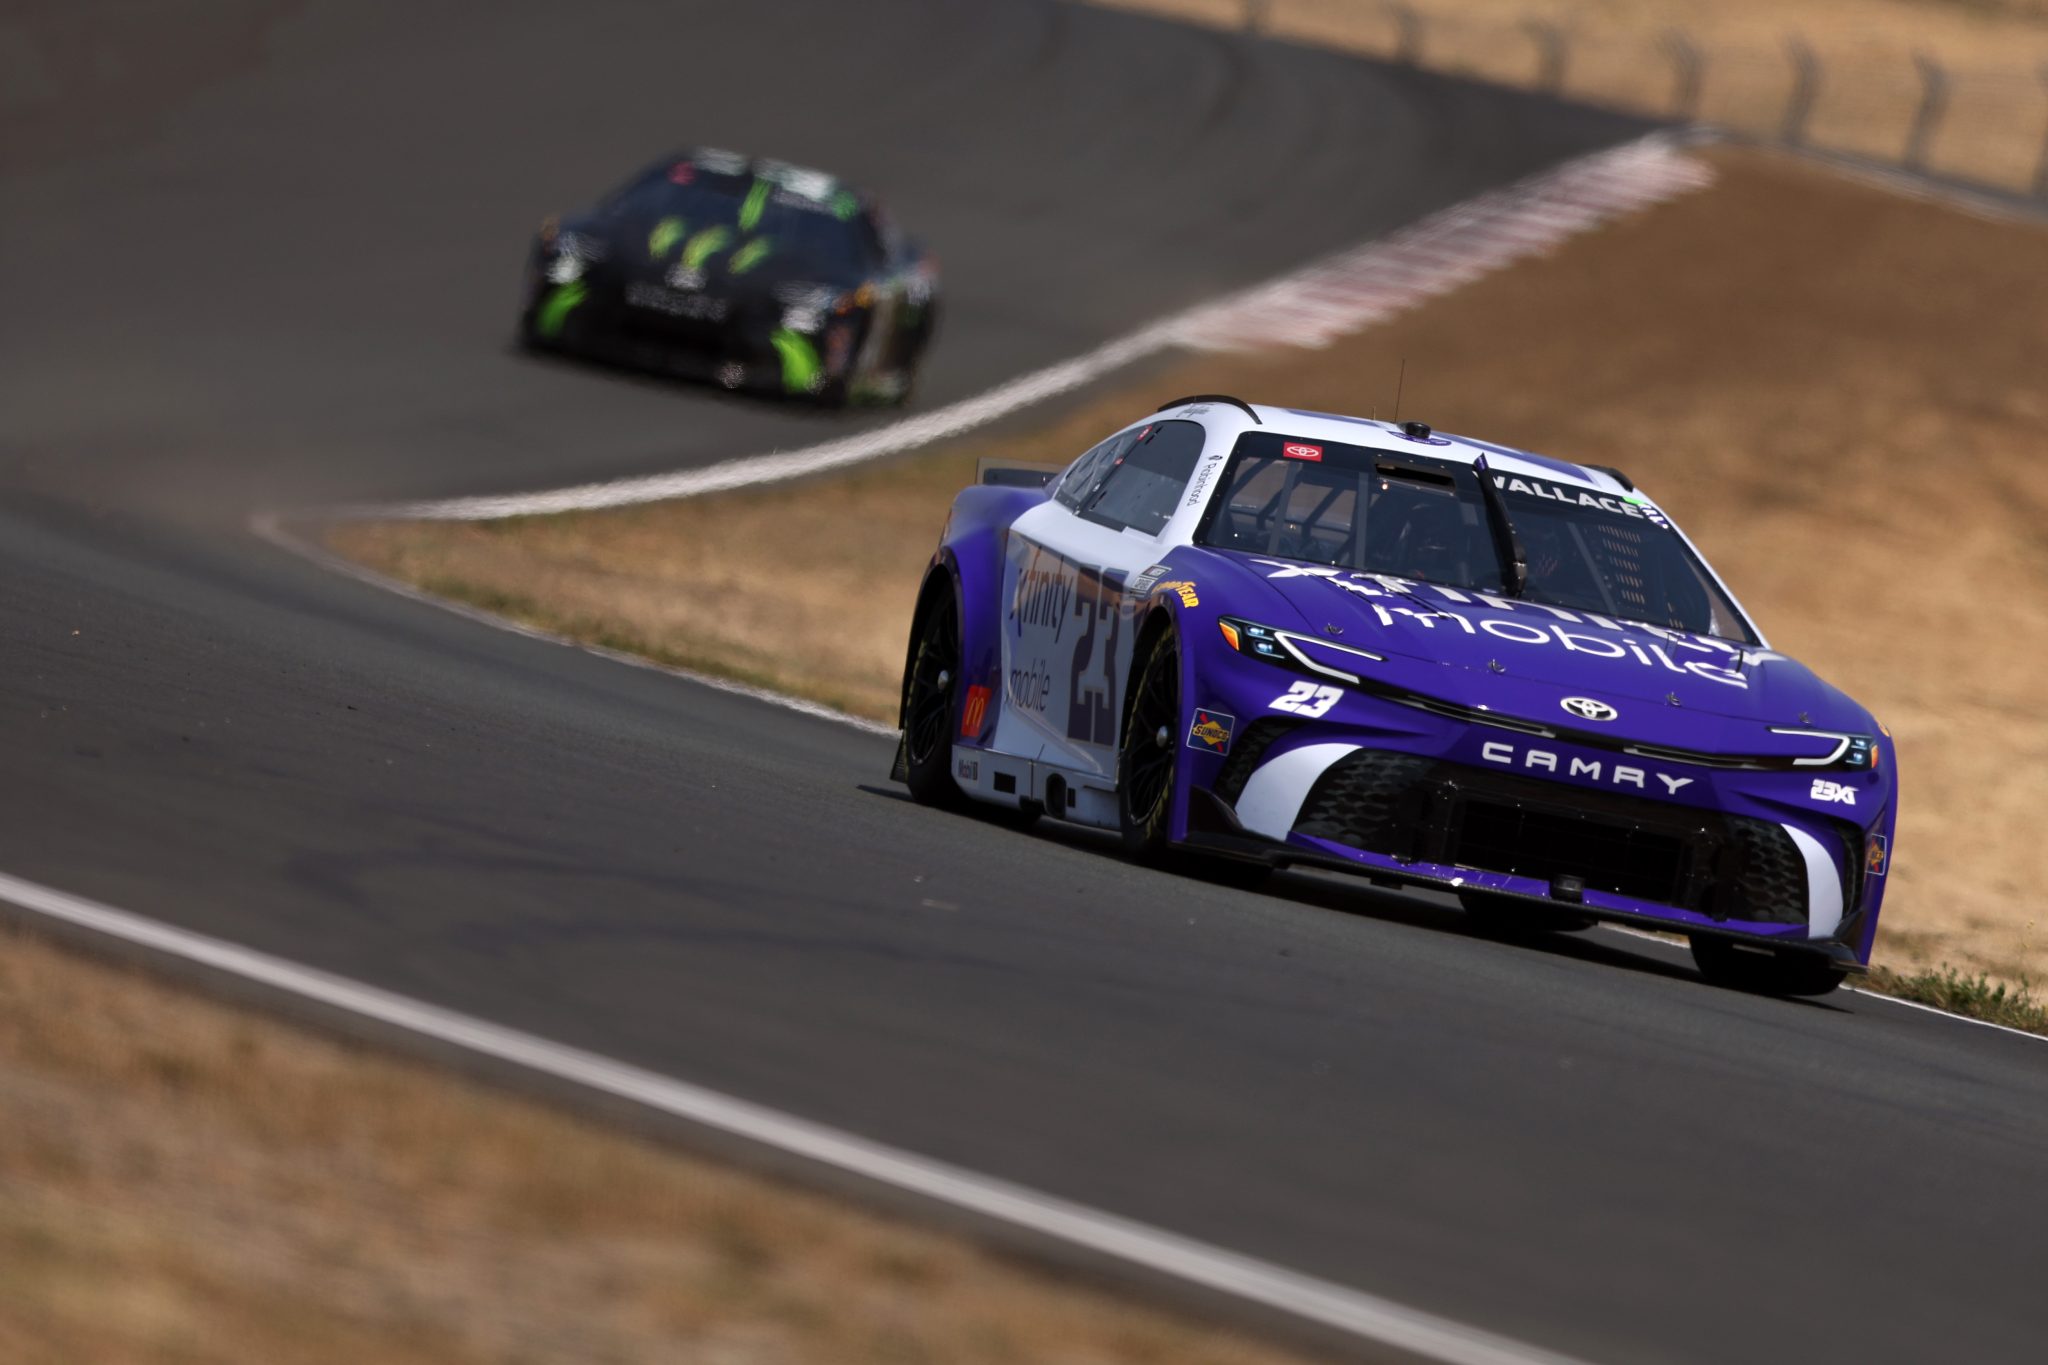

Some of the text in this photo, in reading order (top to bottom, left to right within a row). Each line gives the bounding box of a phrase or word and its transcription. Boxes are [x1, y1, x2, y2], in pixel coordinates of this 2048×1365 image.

[1066, 561, 1130, 747] 23
[1371, 604, 1748, 689] mobile
[1006, 658, 1050, 712] mobile
[1268, 680, 1345, 719] 23
[1194, 725, 1228, 741] SUNOCO
[1482, 741, 1694, 795] CAMRY
